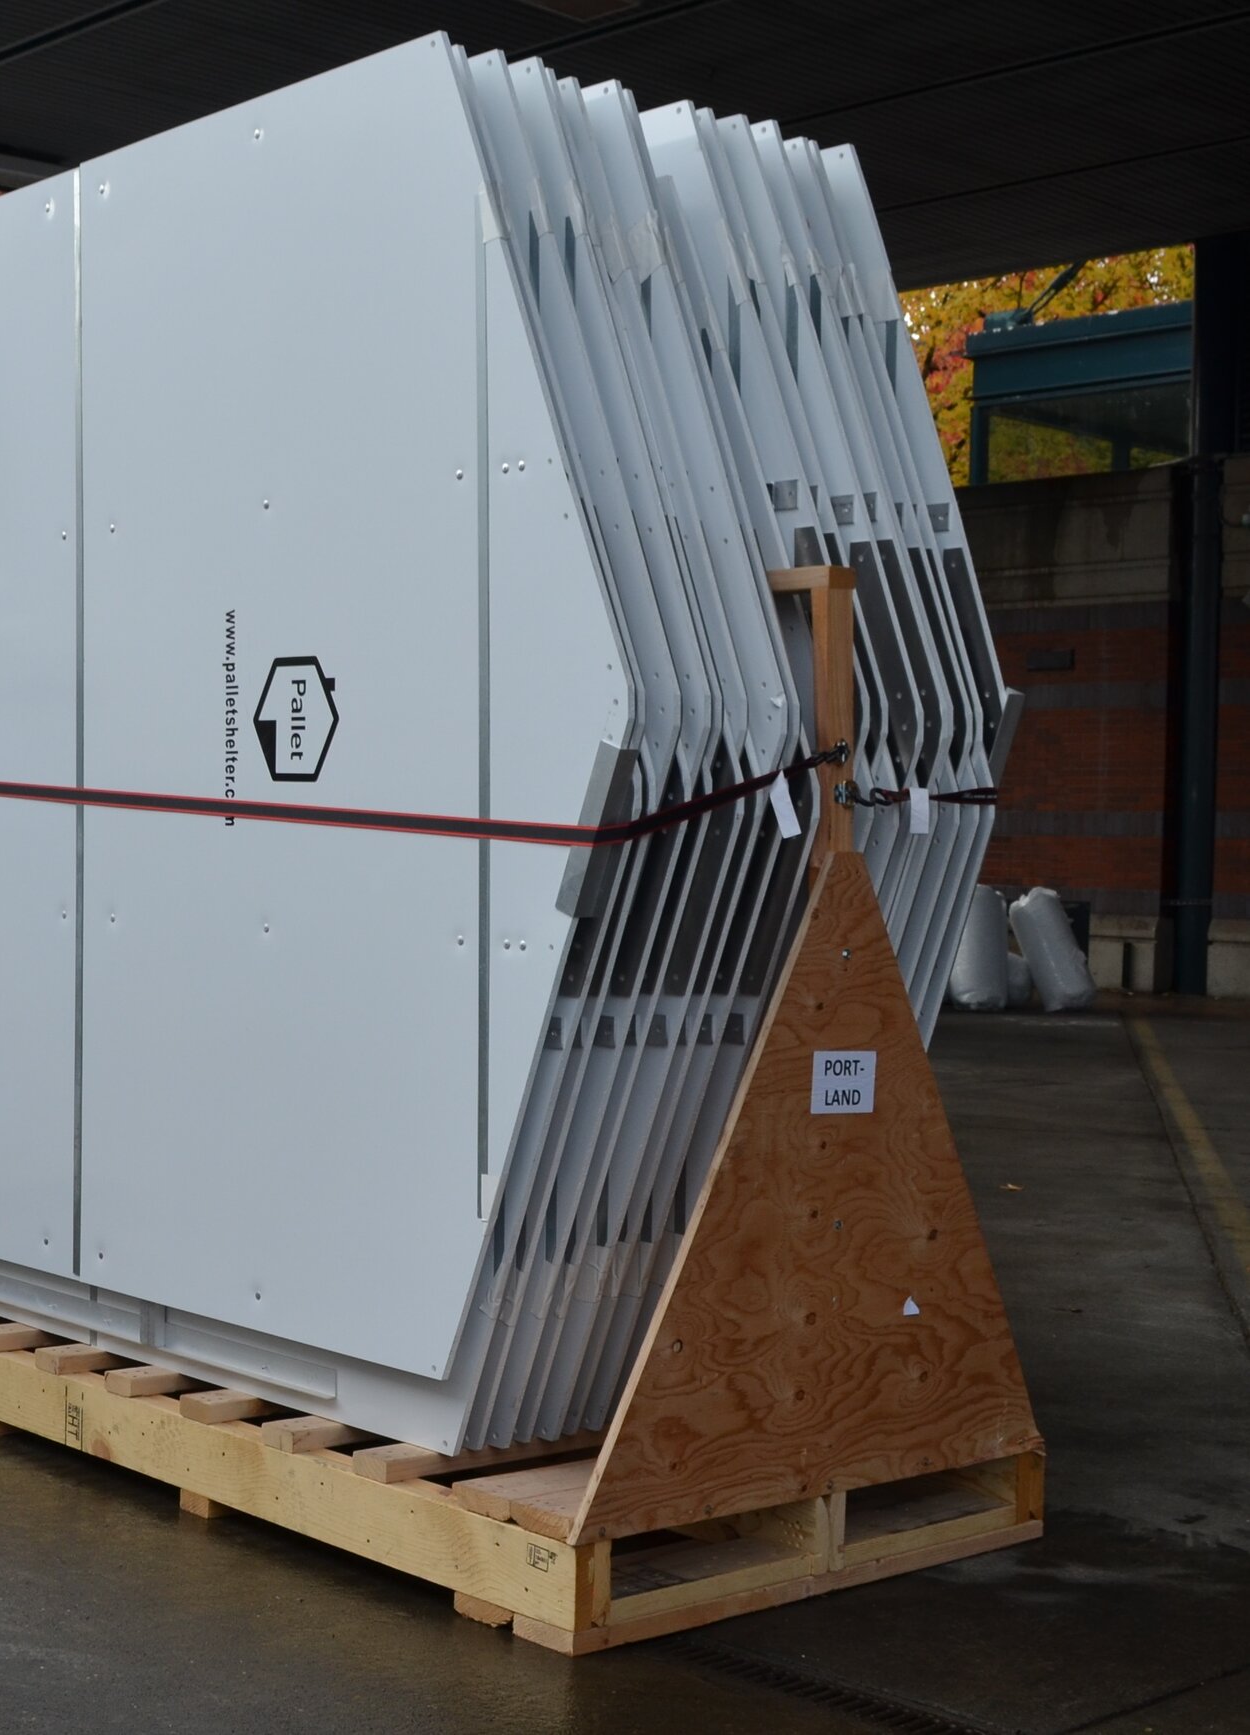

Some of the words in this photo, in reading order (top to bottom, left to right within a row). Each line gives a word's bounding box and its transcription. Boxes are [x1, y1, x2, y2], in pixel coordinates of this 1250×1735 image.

[222, 609, 239, 826] www.palletshelter.cm
[290, 679, 307, 760] Pallet
[824, 1059, 865, 1076] PORT-
[824, 1089, 861, 1106] LAND
